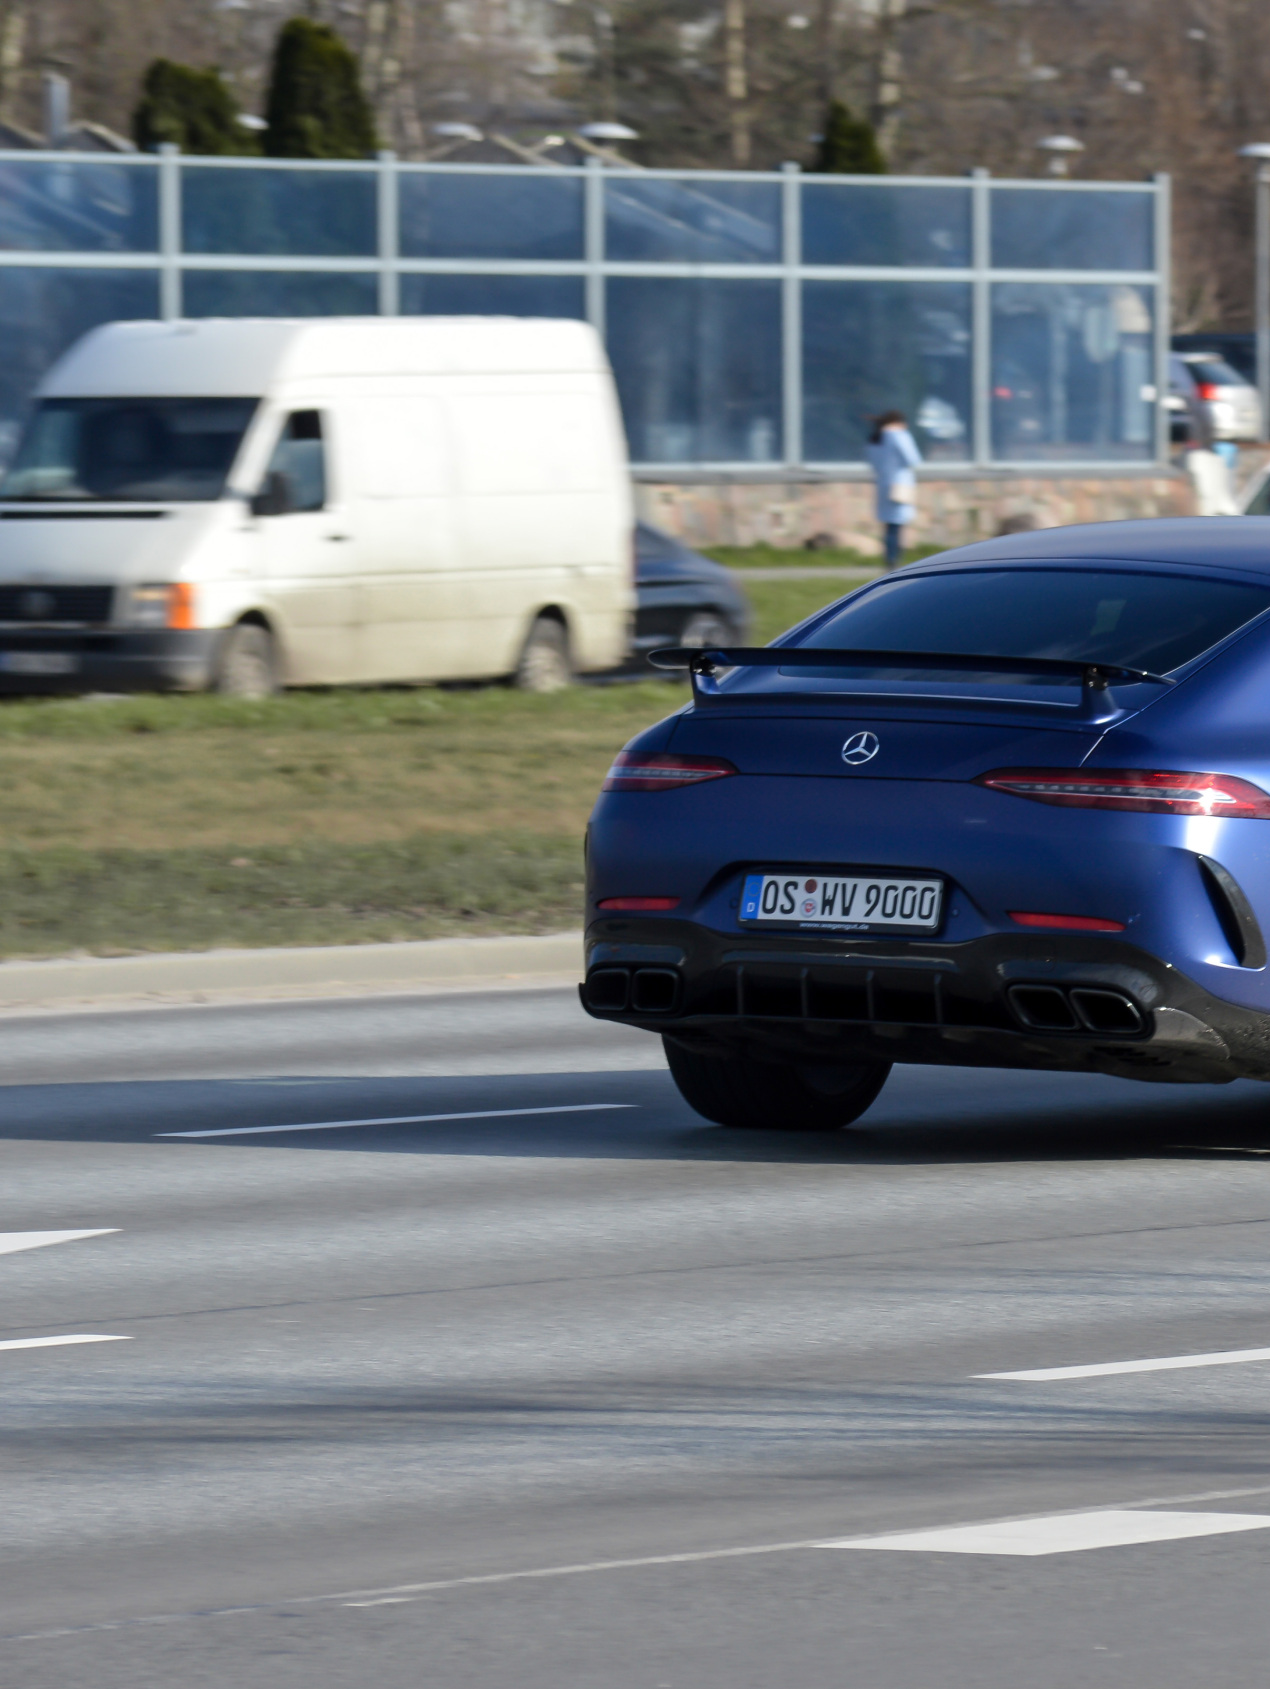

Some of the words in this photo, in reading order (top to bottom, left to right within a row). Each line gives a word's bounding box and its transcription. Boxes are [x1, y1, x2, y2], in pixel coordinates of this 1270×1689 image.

[747, 902, 756, 913] D
[762, 880, 798, 914] OS
[821, 882, 858, 916] WV
[864, 884, 936, 920] 9000
